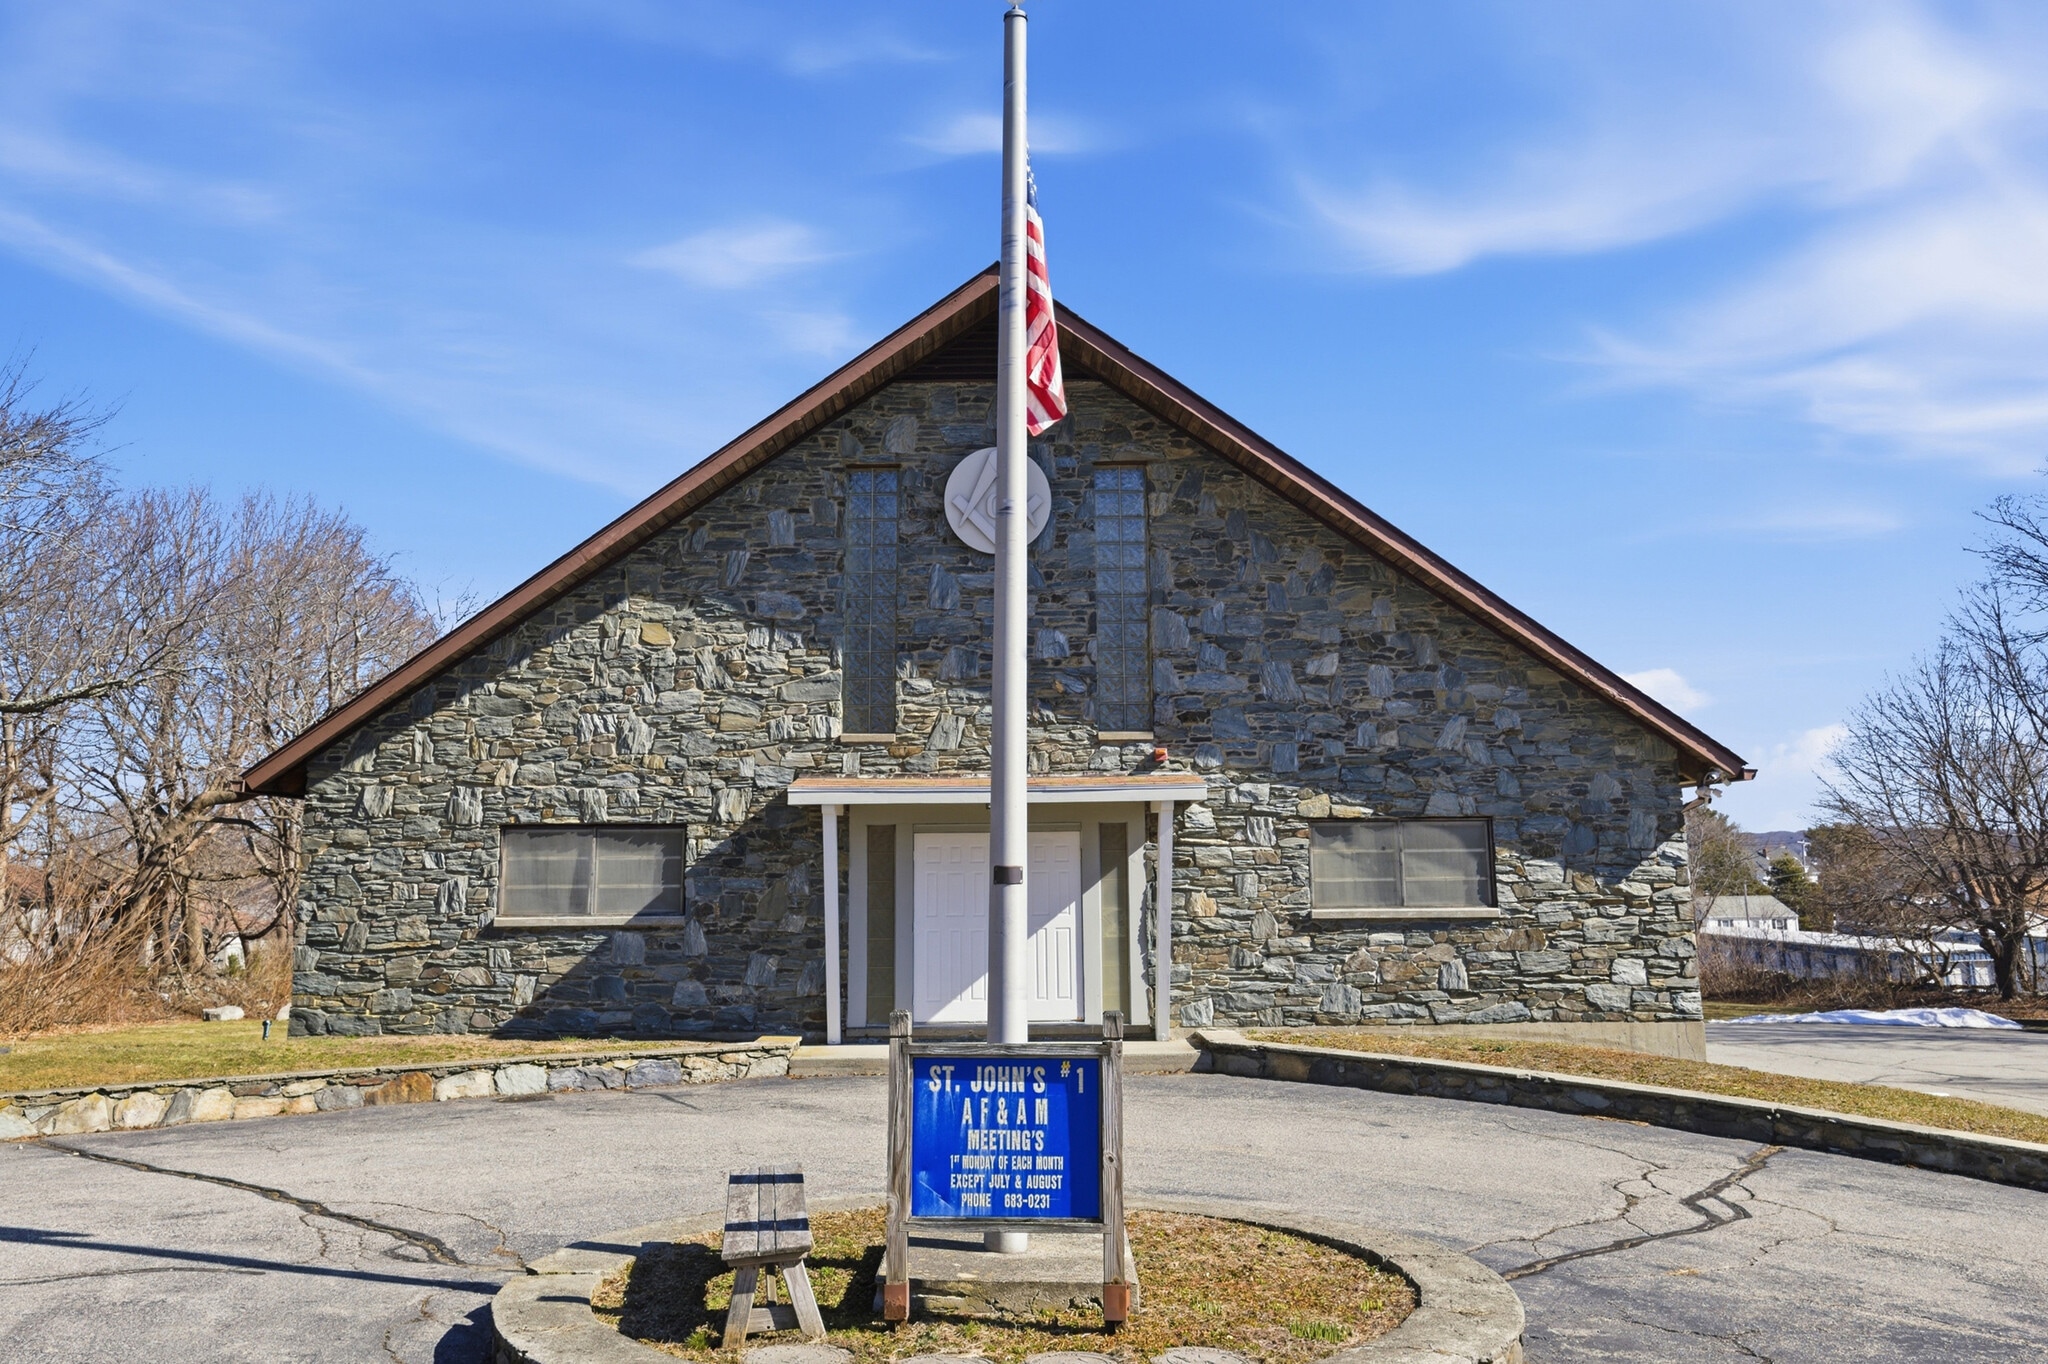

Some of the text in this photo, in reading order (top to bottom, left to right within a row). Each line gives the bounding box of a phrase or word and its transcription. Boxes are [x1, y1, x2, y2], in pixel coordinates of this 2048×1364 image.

[928, 1065, 960, 1093] ST.
[970, 1066, 1046, 1094] JOHN'S
[997, 1097, 1009, 1125] &
[967, 1129, 1045, 1151] MEETING'S
[962, 1155, 995, 1170] MONDAY
[998, 1155, 1009, 1170] OF
[1011, 1156, 1033, 1170] EACH
[1035, 1156, 1064, 1171] MONTH
[950, 1174, 1063, 1189] EXCEPT JULY & AUGUST
[961, 1193, 1050, 1209] PHONE 683-0231
